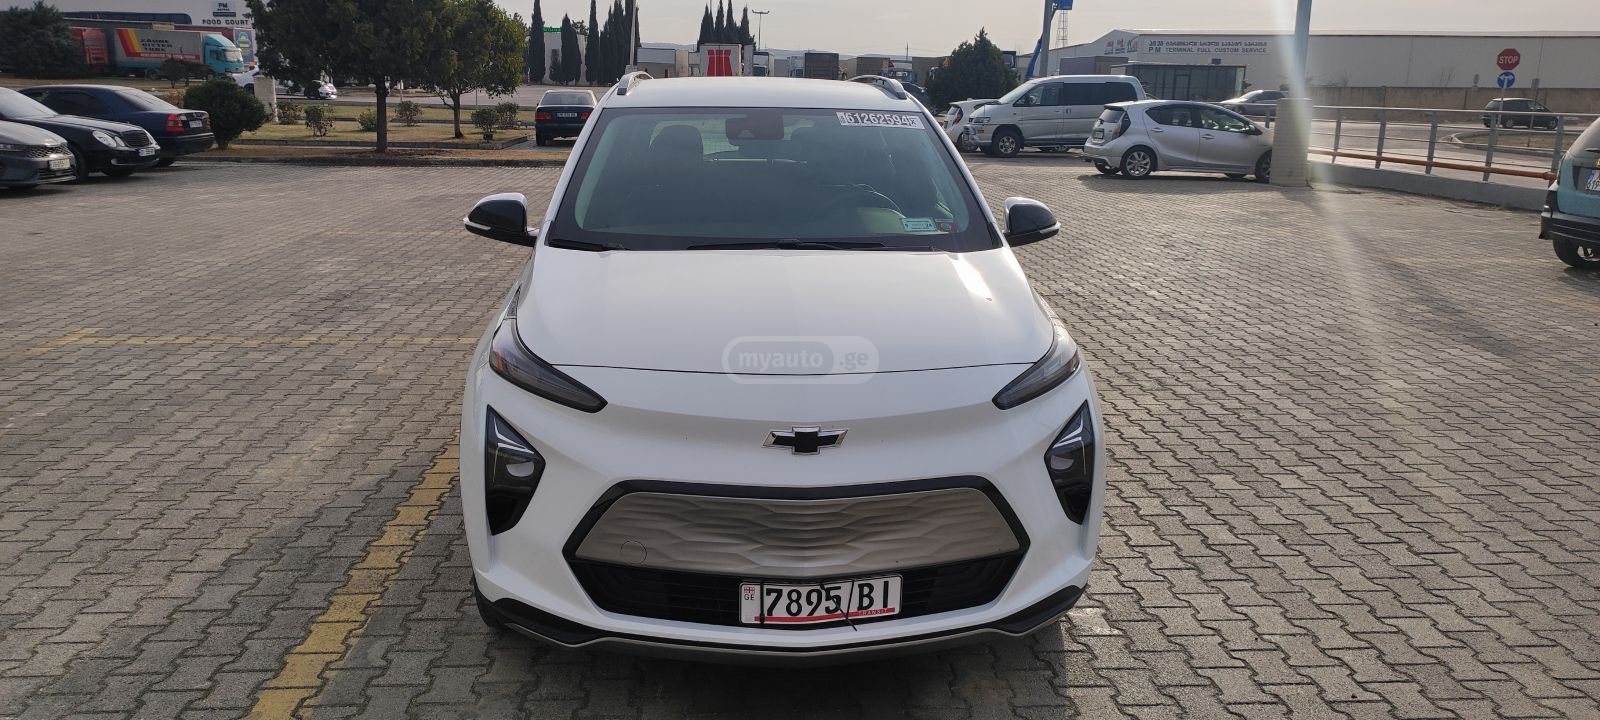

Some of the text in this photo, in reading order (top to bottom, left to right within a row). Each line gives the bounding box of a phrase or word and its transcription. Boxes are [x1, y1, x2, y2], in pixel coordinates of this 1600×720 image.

[1499, 55, 1519, 64] STOP
[845, 112, 911, 126] 61262594
[744, 593, 755, 601] GE
[765, 586, 842, 617] 7895
[859, 608, 888, 616] TRANSIT
